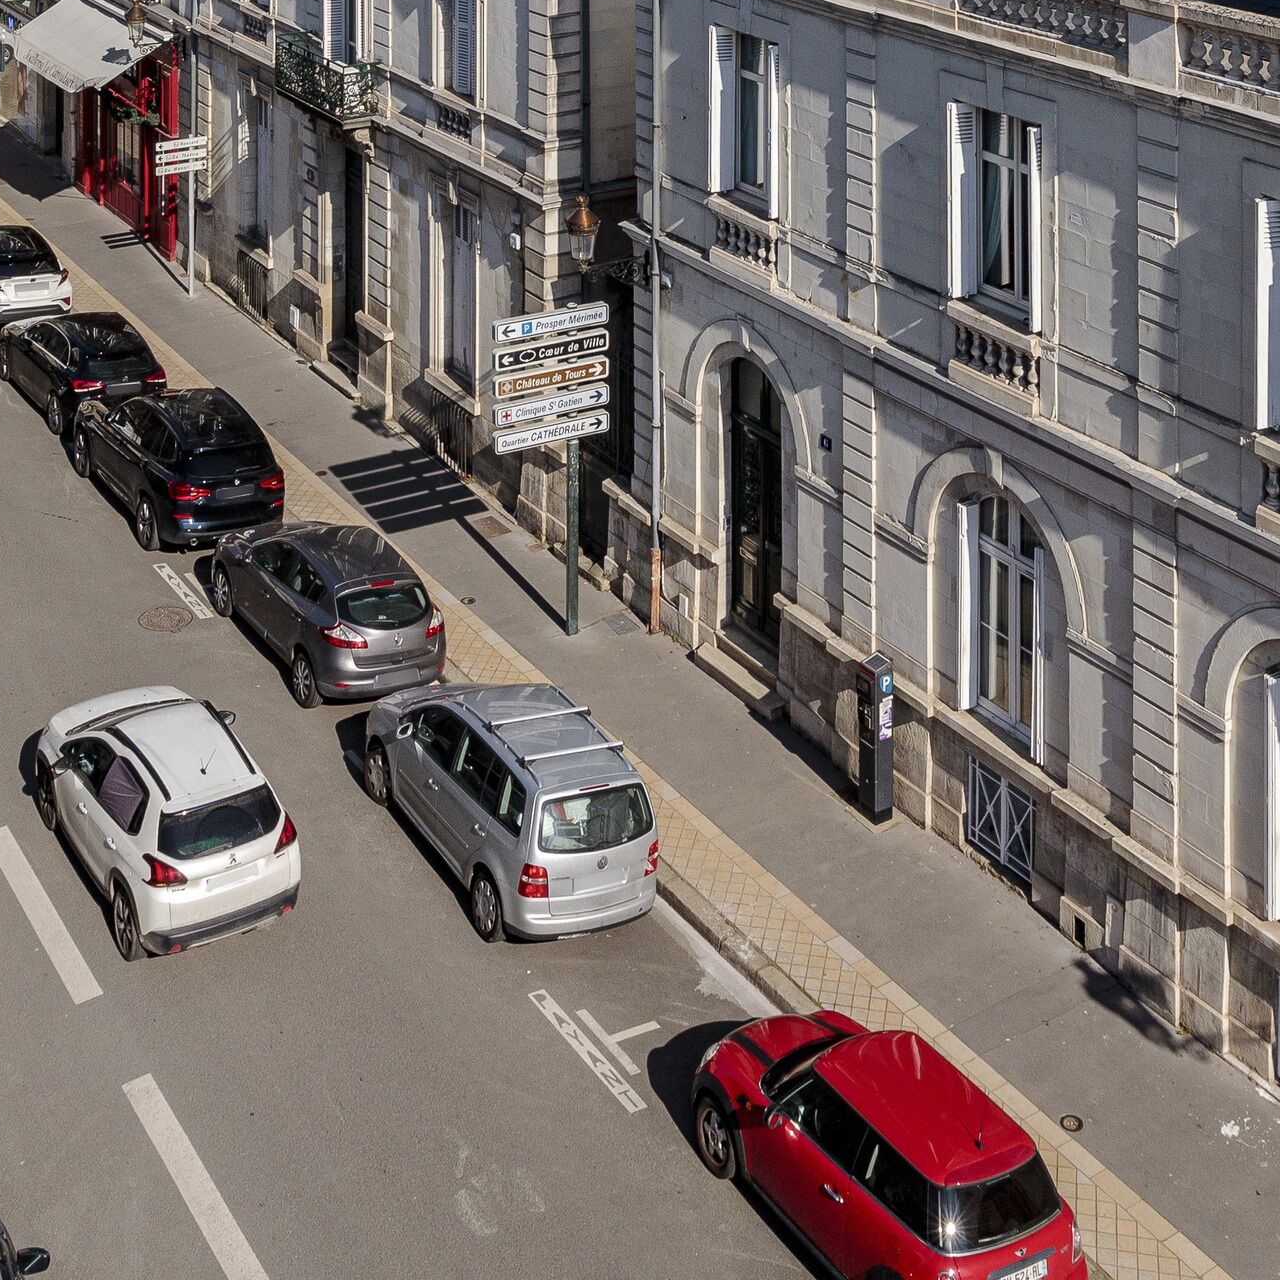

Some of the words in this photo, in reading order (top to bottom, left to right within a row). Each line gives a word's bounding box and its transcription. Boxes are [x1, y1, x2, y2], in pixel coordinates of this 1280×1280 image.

[535, 318, 566, 330] Prosper
[568, 311, 603, 324] Mérimée
[538, 345, 564, 358] Cœur
[567, 342, 579, 352] de
[583, 337, 605, 349] Ville
[516, 376, 550, 390] Château
[552, 373, 562, 382] de
[565, 369, 586, 380] Tours
[515, 404, 547, 418] Clinique
[548, 400, 557, 411] St
[557, 397, 583, 409] Gatien
[501, 436, 529, 448] Quartier
[530, 422, 586, 442] CATHÉDRALE
[532, 993, 638, 1108] PAYANT
